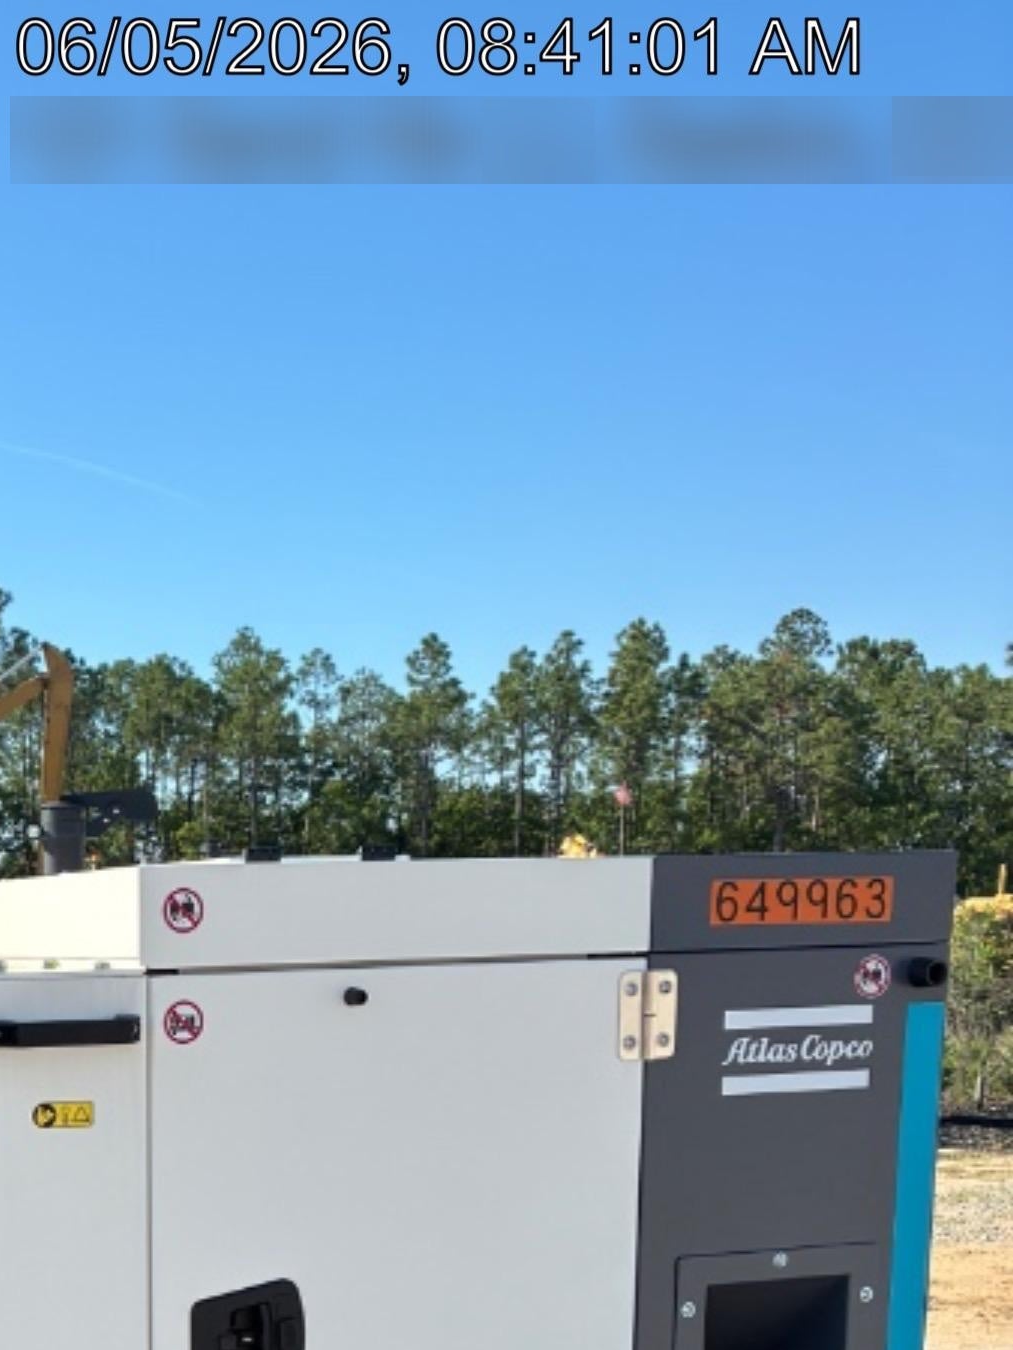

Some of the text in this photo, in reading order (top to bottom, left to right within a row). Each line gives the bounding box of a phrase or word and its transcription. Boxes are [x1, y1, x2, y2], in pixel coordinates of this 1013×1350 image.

[715, 878, 887, 922] 649963
[721, 1034, 874, 1066] Atlas Copco
